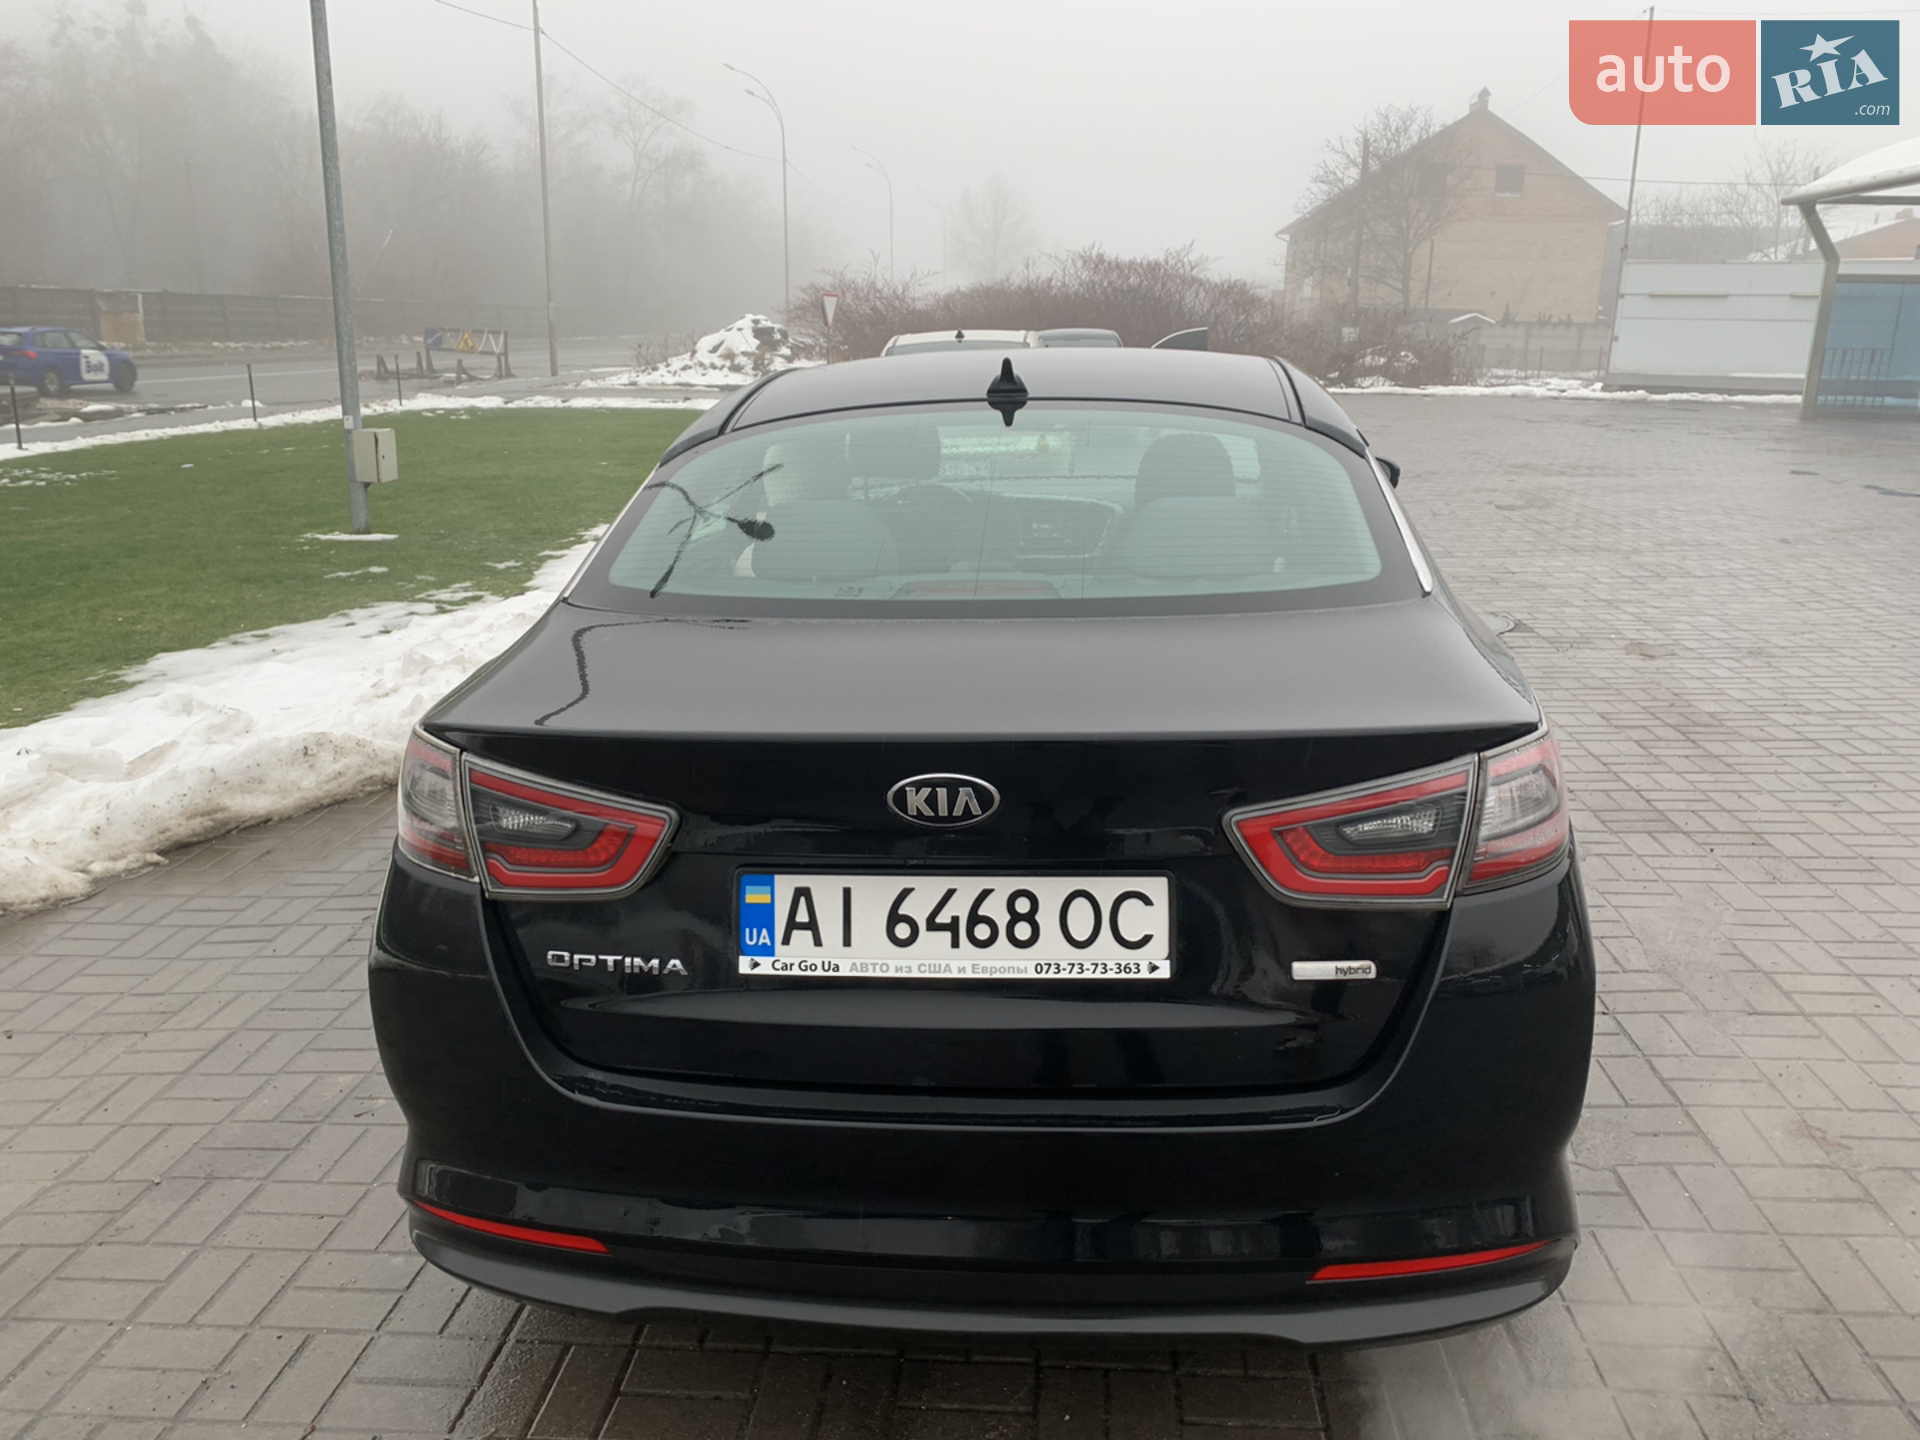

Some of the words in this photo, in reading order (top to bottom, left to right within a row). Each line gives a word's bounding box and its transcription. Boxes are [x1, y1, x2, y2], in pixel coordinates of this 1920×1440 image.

[905, 787, 982, 816] KIA
[781, 886, 852, 947] AI
[885, 887, 1041, 949] 6468
[1059, 888, 1155, 950] OC
[745, 928, 771, 946] UA
[546, 950, 688, 975] OPTIMA
[771, 959, 795, 972] Car
[798, 959, 818, 972] Go
[821, 960, 840, 972] Ua
[849, 962, 890, 973] АВТО
[894, 964, 913, 974] из
[917, 962, 953, 974] США
[957, 965, 967, 974] и
[971, 963, 1028, 976] Европы
[1034, 962, 1141, 974] 073-73-73-363
[1335, 965, 1372, 977] hybrid
